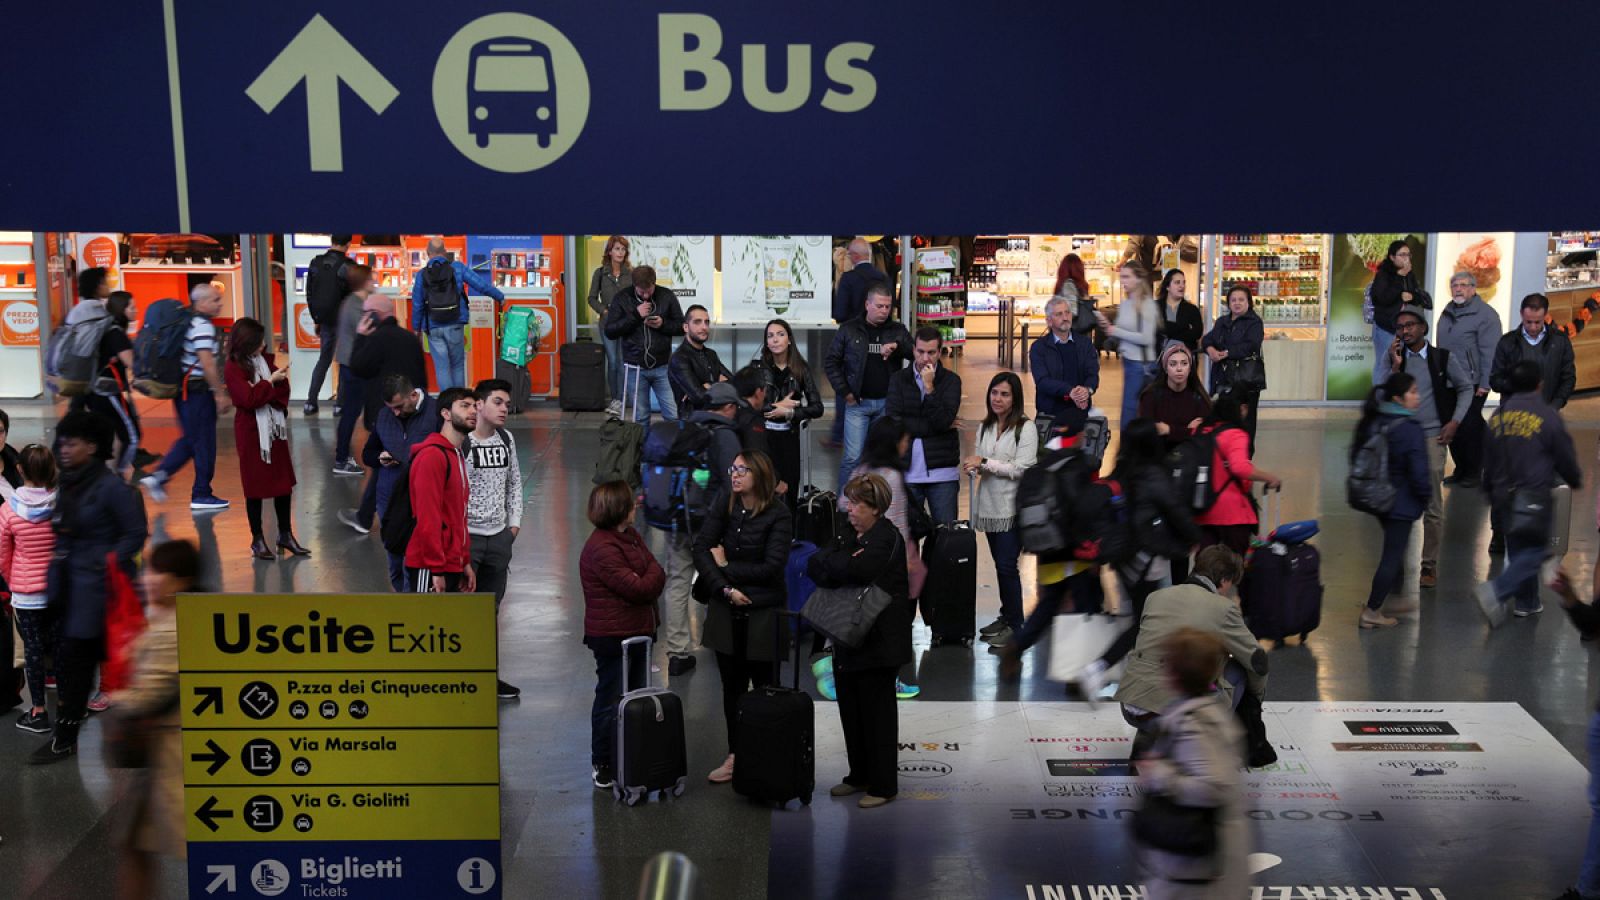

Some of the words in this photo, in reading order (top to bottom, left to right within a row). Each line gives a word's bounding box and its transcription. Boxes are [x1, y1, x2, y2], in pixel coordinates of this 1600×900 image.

[658, 12, 877, 113] Bus
[476, 447, 506, 467] KEEP
[213, 610, 375, 655] Uscite
[388, 623, 462, 654] Exits
[287, 681, 332, 695] P.zza
[338, 680, 365, 695] dei
[370, 680, 478, 698] Cinquecento
[289, 737, 319, 752] Via
[324, 737, 397, 752] Marsala
[291, 794, 321, 808] Via
[326, 794, 347, 808] G.
[352, 793, 411, 808] Giolitti
[1010, 808, 1139, 820] UNGE
[1244, 810, 1385, 821] FOOD
[300, 856, 402, 883] Biglietti
[301, 884, 348, 898] Tickets
